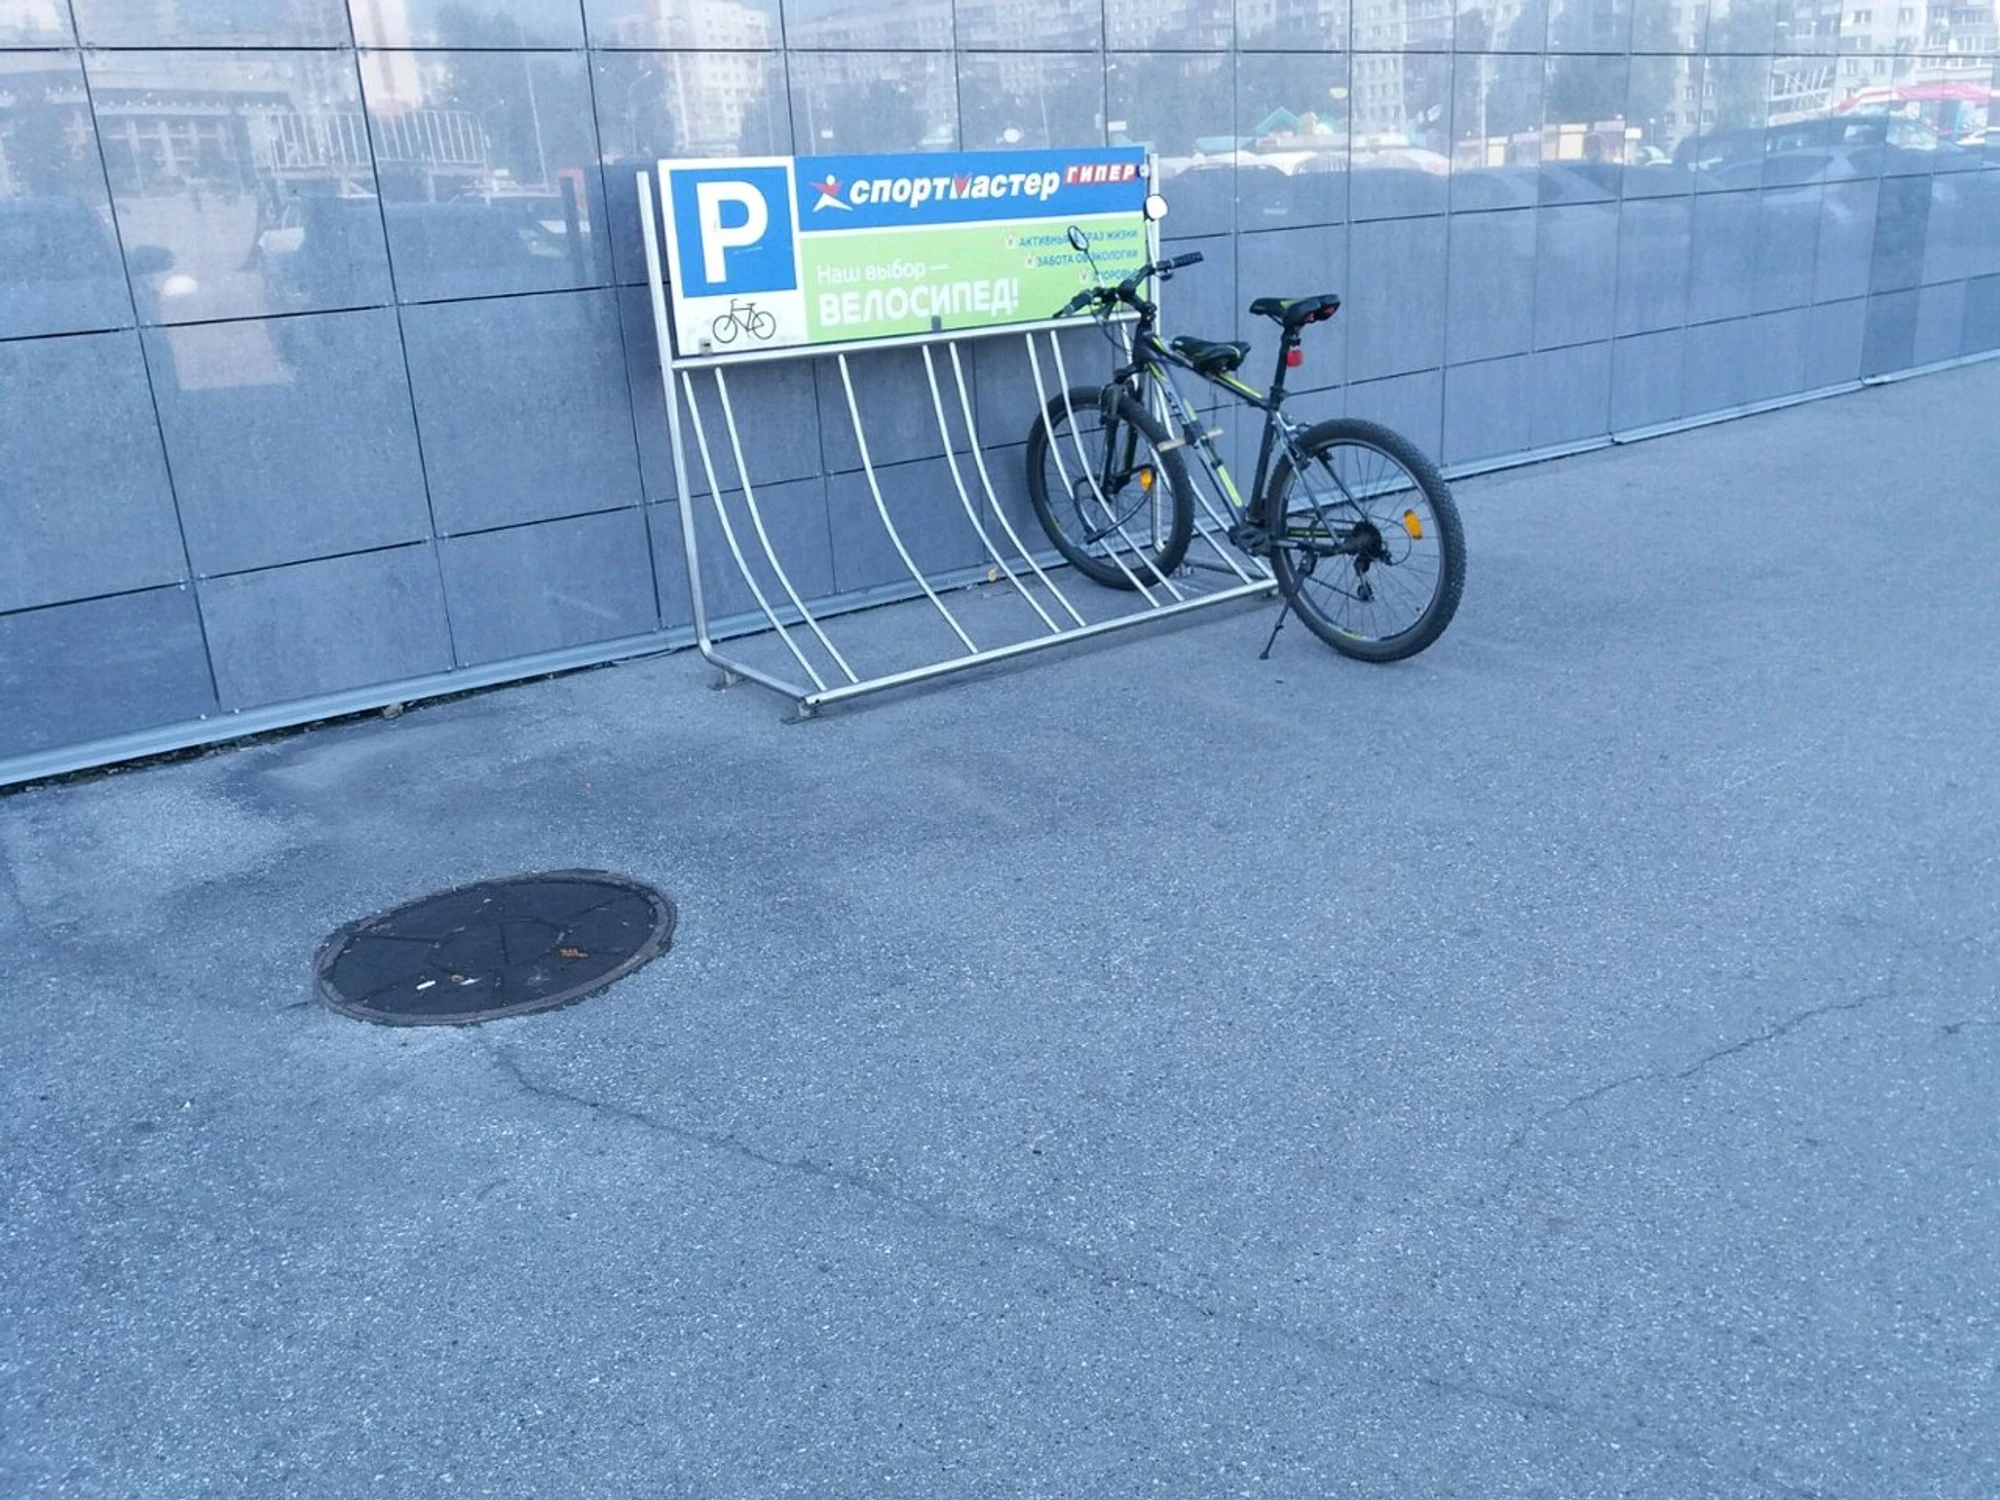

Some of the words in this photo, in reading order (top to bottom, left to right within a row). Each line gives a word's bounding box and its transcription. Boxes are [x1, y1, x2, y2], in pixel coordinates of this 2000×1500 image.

[1067, 164, 1135, 183] ГИПЕР
[696, 181, 768, 284] P
[1019, 235, 1068, 247] АКТИВНЫ
[1106, 230, 1138, 240] ЖИЗНИ
[1037, 255, 1073, 266] ЗАБОТА
[816, 266, 861, 285] Наш
[866, 260, 926, 280] выбор
[819, 278, 1020, 326] ВЕЛОСИПЕД!
